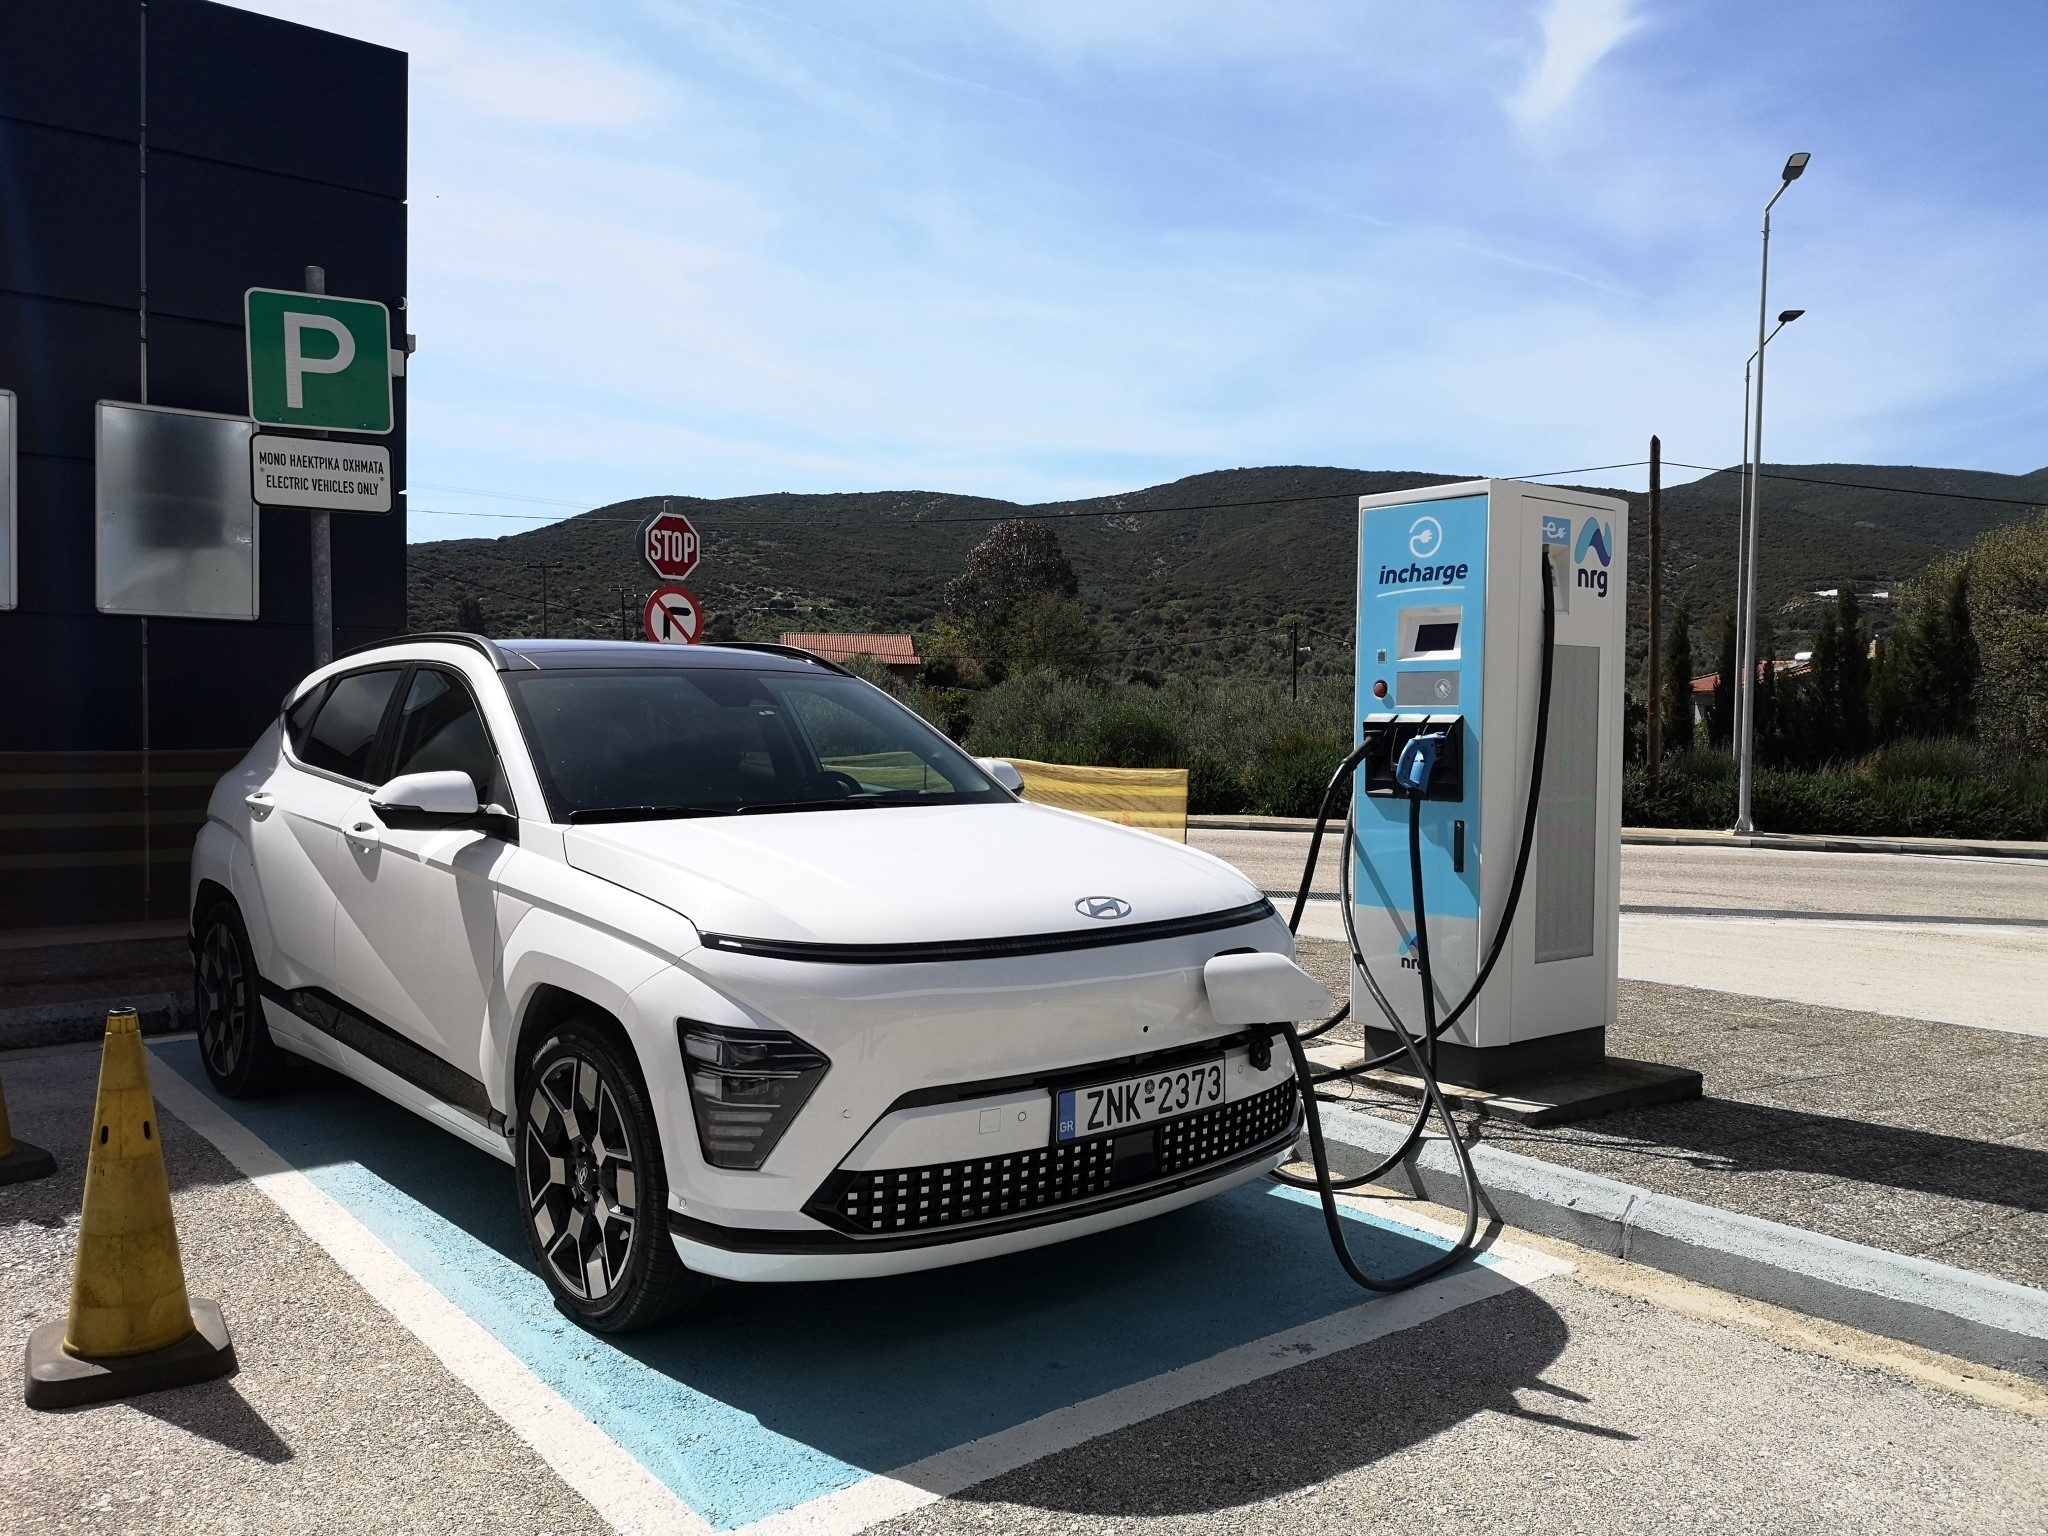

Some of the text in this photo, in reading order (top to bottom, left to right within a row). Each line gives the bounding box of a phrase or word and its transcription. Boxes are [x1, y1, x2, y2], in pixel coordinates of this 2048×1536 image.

[284, 311, 356, 409] P
[259, 451, 384, 475] ΜΟΝΟ ΗΛΕΚΤΡΙΚΑ ΟΧΗΜΑΤΑ
[266, 475, 379, 496] ELECTRIC VEHICLES ONLY
[650, 529, 695, 563] STOP
[1378, 562, 1469, 586] incharge
[1577, 568, 1608, 598] nrg
[1087, 1065, 1221, 1131] ZNK-2373
[1059, 1120, 1075, 1133] GR
